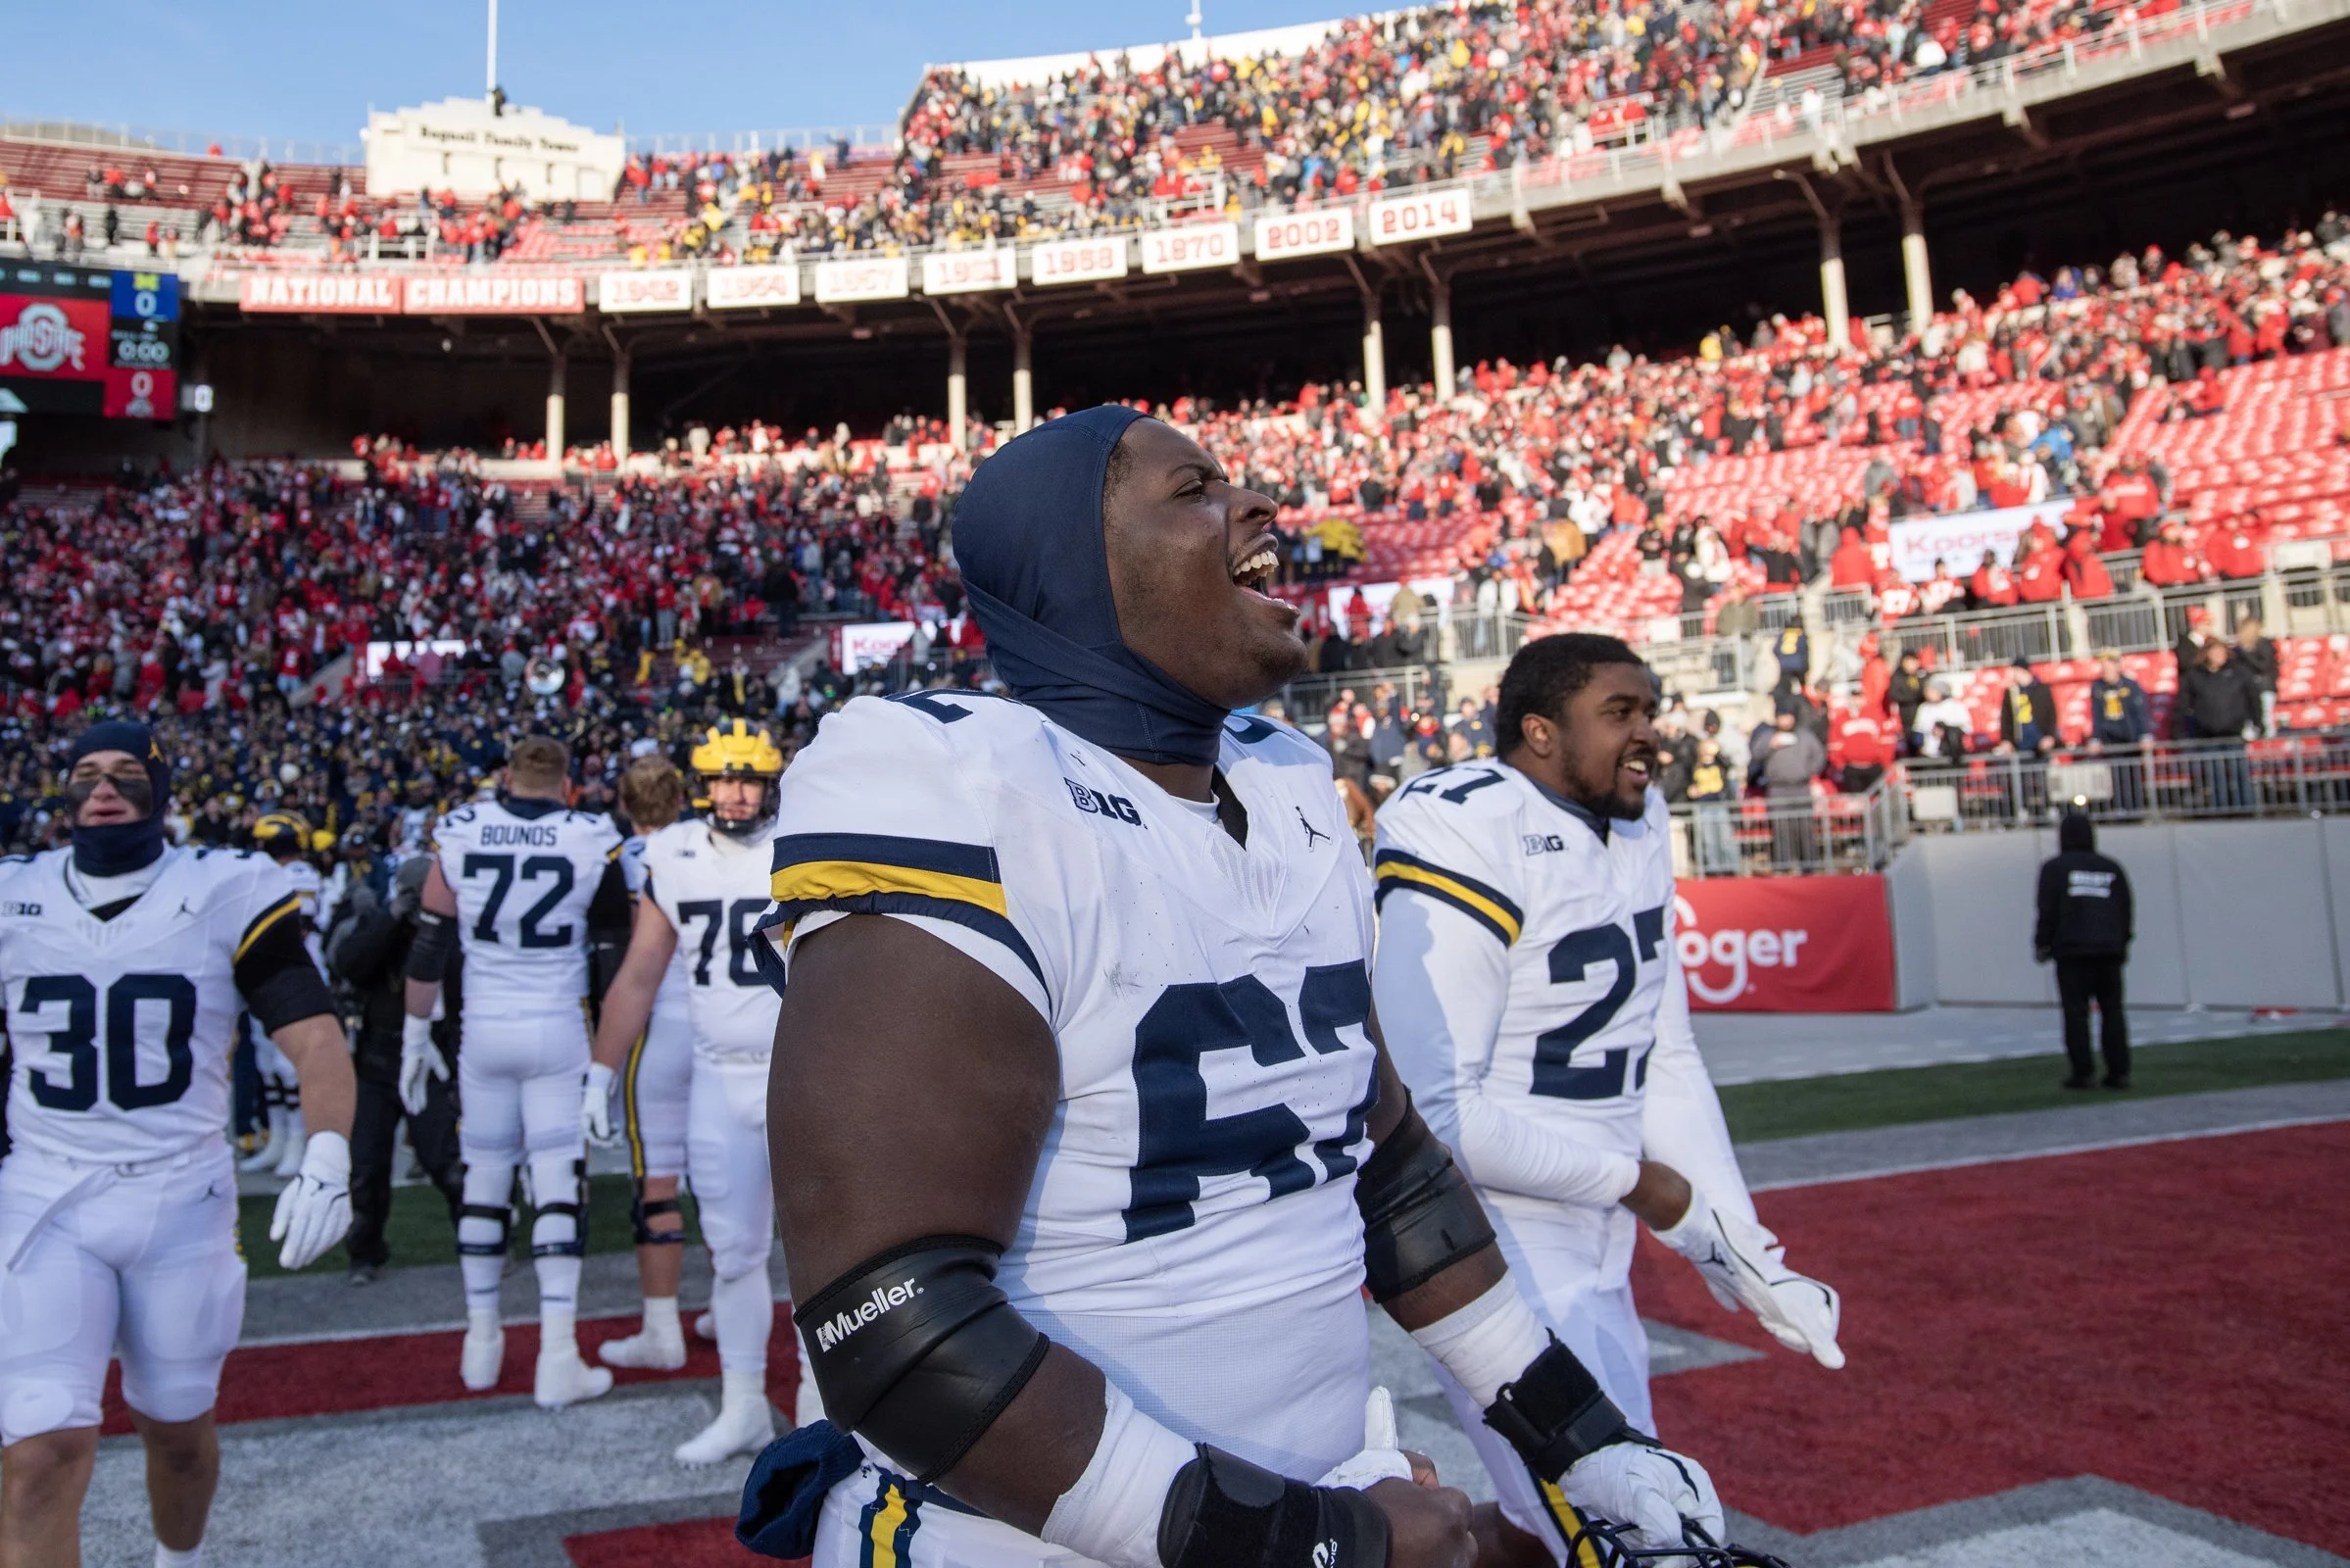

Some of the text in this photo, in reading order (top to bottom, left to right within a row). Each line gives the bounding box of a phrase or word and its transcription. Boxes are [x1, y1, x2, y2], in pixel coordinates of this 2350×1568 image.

[1383, 200, 1458, 234] 2014
[1155, 234, 1224, 264] 1970
[1268, 219, 1341, 249] 2002
[134, 291, 157, 318] 0
[250, 277, 577, 306] NATIONAL CHAMPIONS
[118, 340, 170, 364] 0:00
[130, 371, 154, 398] 0
[463, 855, 574, 948] 72
[19, 973, 197, 1111] 30
